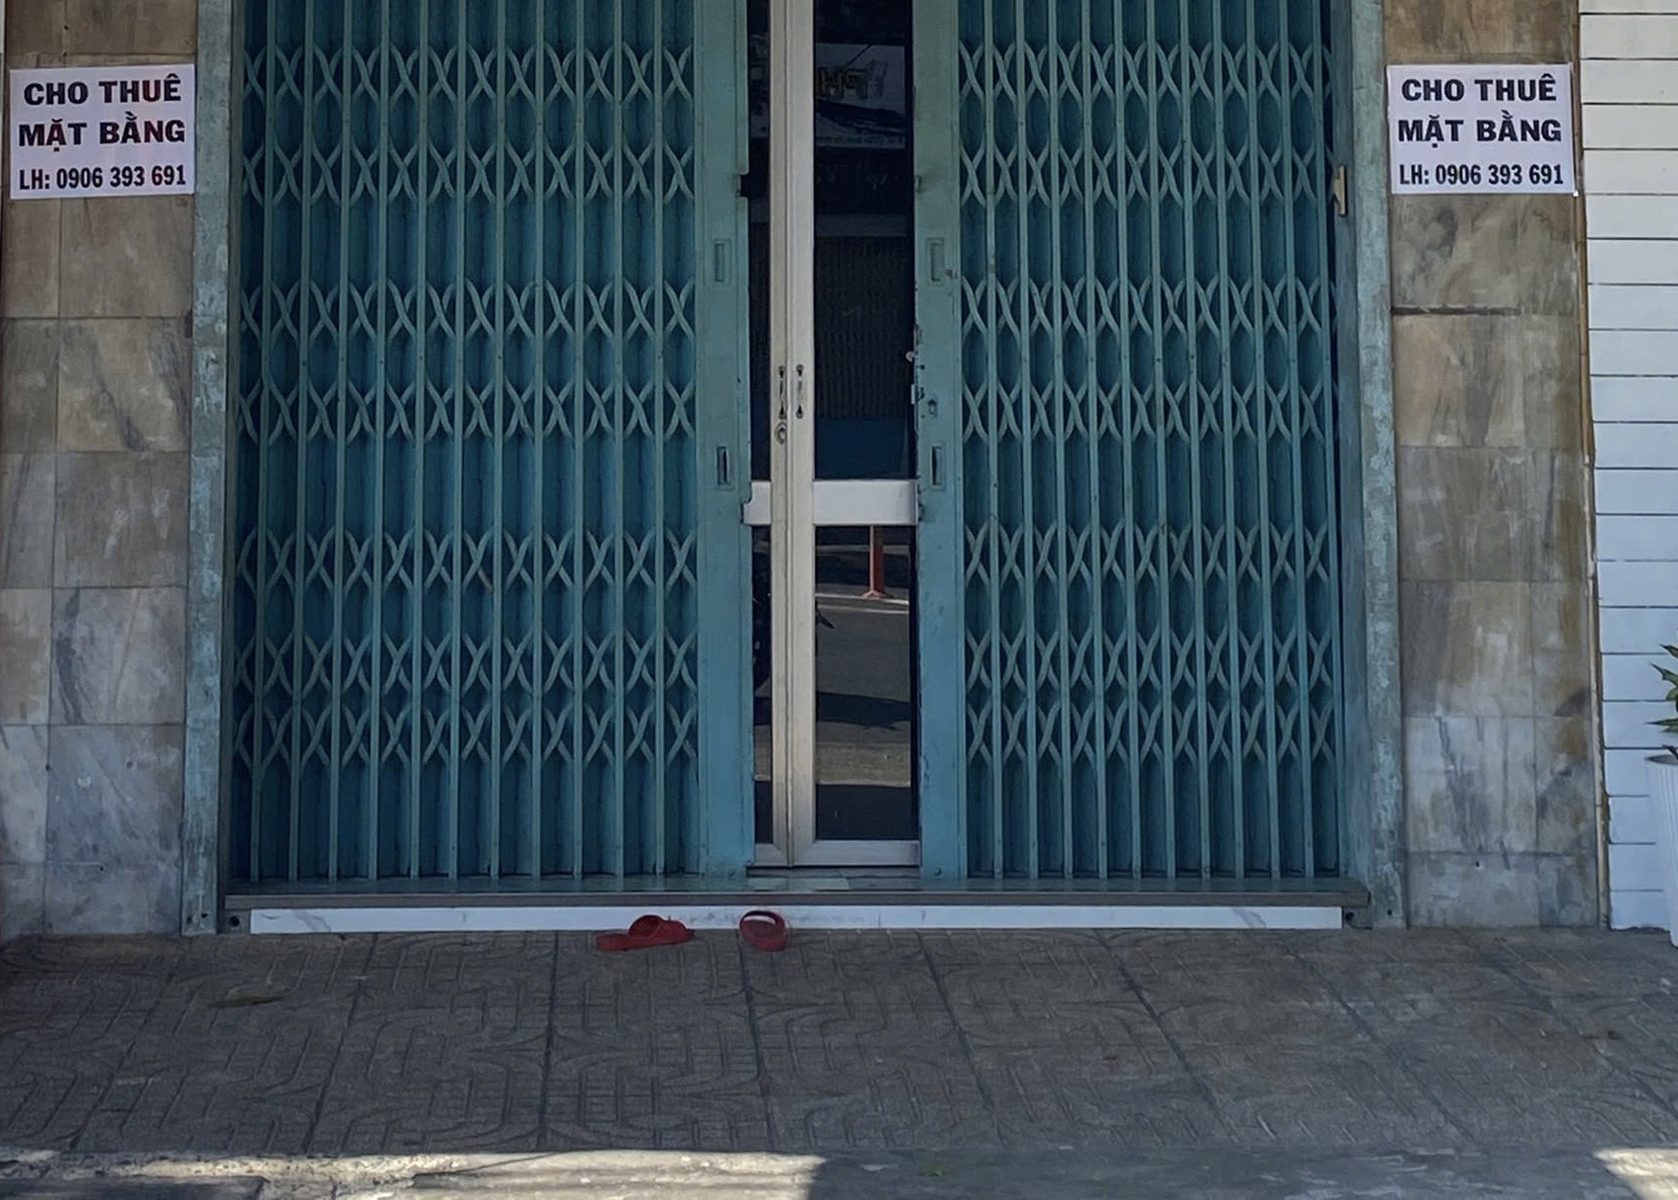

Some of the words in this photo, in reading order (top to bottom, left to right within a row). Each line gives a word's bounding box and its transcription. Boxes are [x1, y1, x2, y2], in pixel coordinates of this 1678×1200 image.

[23, 81, 89, 106] CHO
[98, 73, 181, 104] THUÊ
[1401, 78, 1465, 101] CHO
[1474, 73, 1557, 102] THUÊ
[18, 118, 88, 152] MẶT
[99, 110, 186, 145] BẰNG
[1397, 114, 1464, 148] MẶT
[1476, 109, 1562, 142] BẰNG
[19, 168, 50, 190] LH:
[56, 167, 104, 189] 0906
[109, 165, 146, 187] 393
[151, 164, 187, 186] 691
[1399, 164, 1430, 185] LH:
[1434, 164, 1482, 185] 0906
[1488, 164, 1523, 185] 393
[1529, 164, 1564, 185] 691
